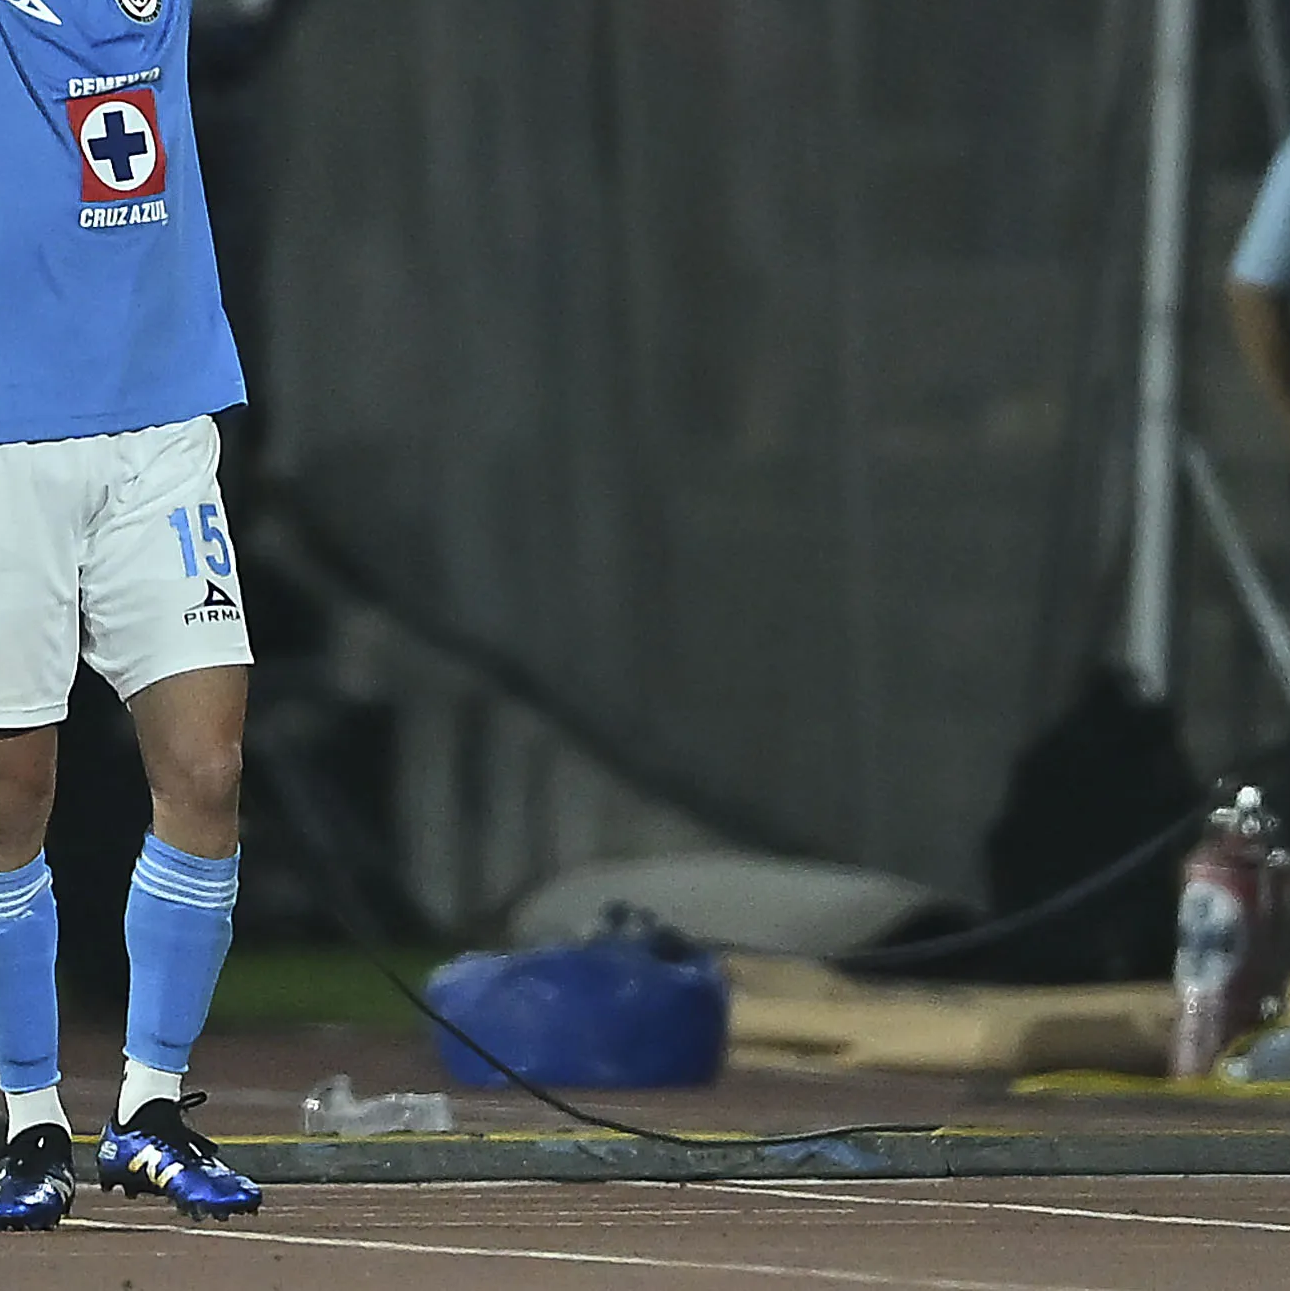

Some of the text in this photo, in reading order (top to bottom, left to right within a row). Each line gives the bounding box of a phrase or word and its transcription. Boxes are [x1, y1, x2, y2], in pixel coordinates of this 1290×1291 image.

[79, 200, 169, 228] CRUZ AZUL
[168, 503, 232, 577] 15
